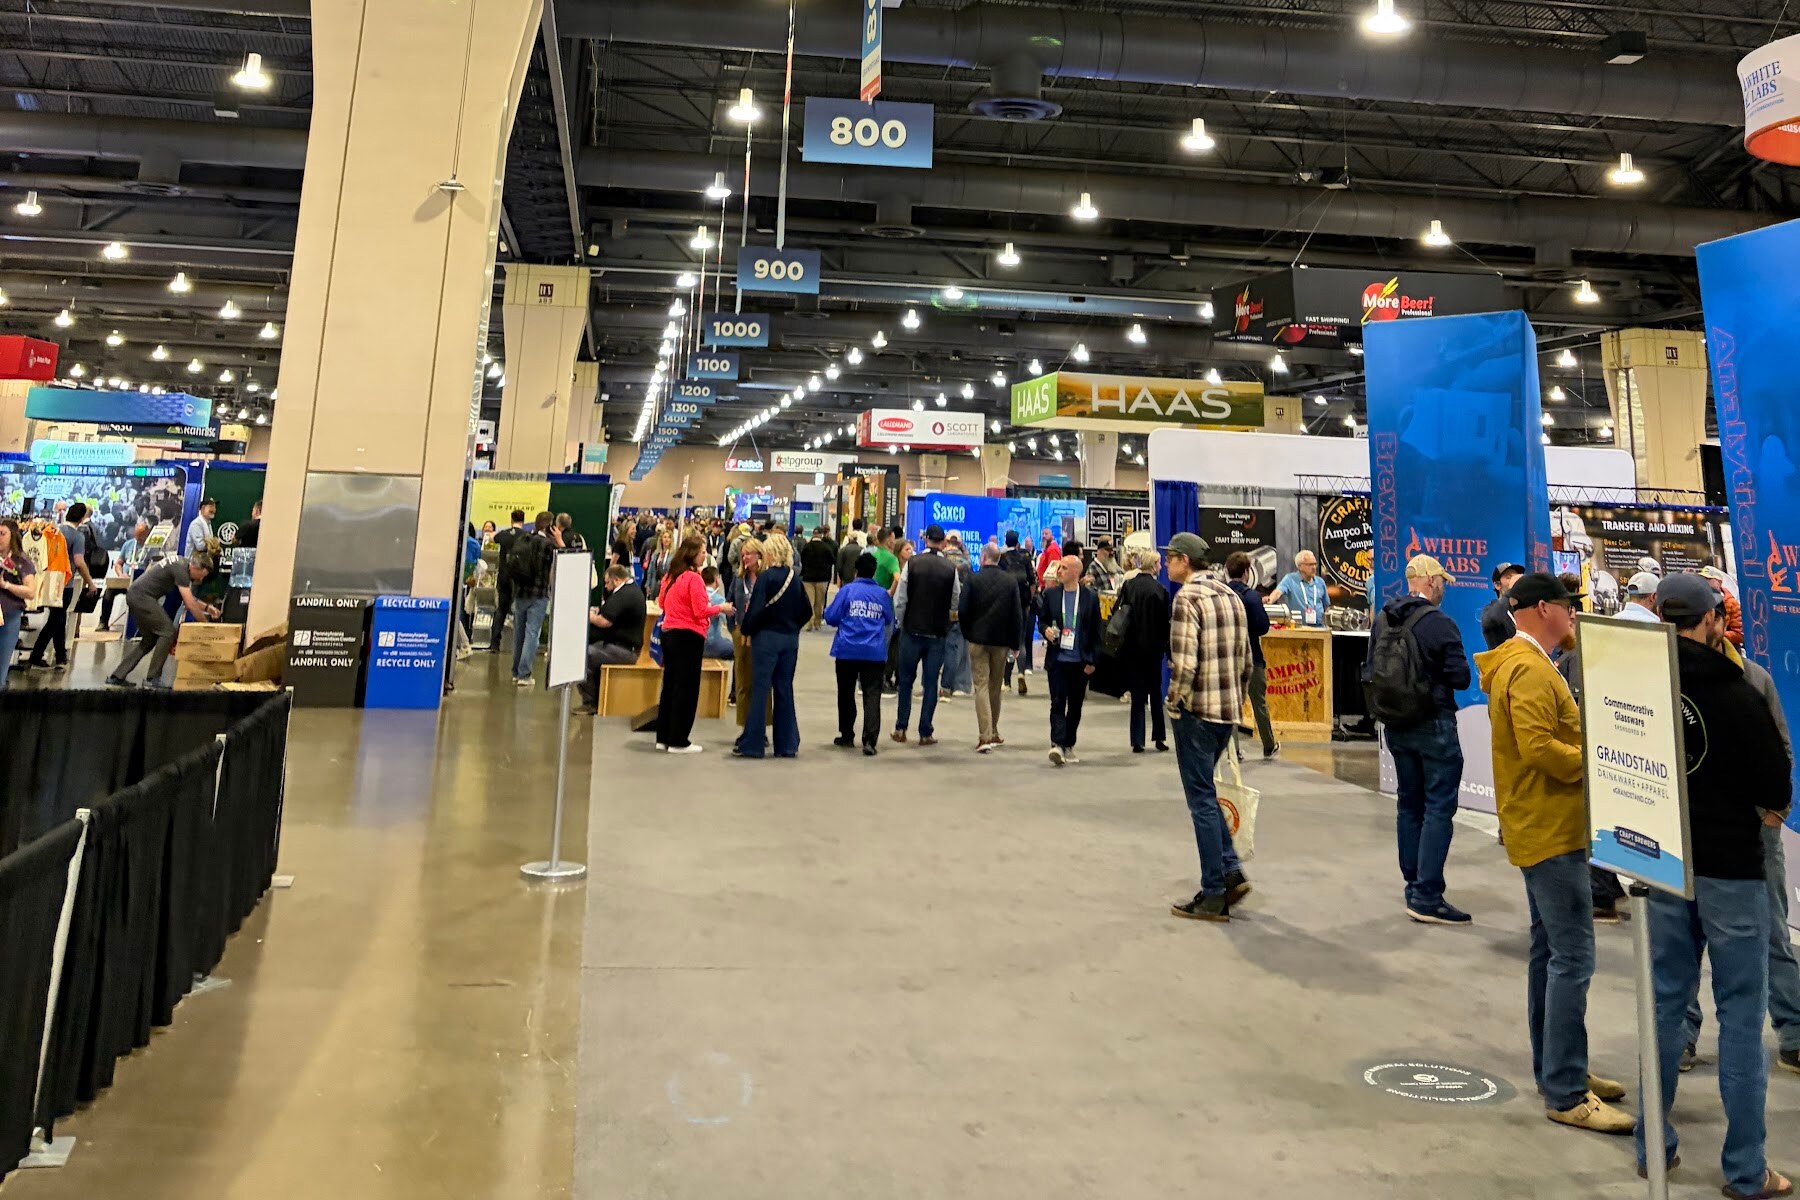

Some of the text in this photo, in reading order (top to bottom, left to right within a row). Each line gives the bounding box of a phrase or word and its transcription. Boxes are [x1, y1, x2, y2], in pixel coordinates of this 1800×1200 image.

[1745, 61, 1782, 89] WHITE
[1750, 80, 1778, 101] LABS
[829, 116, 907, 149] 800
[754, 258, 804, 281] 900
[1401, 308, 1432, 317] Professional
[712, 321, 761, 338] 1000
[696, 358, 730, 372] 1100
[680, 384, 710, 397] 1200
[671, 402, 697, 413] 1300
[1016, 382, 1049, 419] HAAS
[1091, 382, 1232, 420] HAAS
[663, 415, 687, 423] 1400
[947, 422, 979, 432] SCOTT
[658, 428, 678, 436] 1500
[1375, 432, 1398, 572] Brewers
[933, 500, 966, 521] Saxco
[1092, 516, 1106, 525] MB
[1602, 520, 1694, 535] TRANSFER AND MIXING
[1325, 526, 1360, 540] Ampco
[1424, 536, 1488, 556] WHITE
[297, 598, 359, 608] LANDFILL ONLY
[382, 599, 442, 608] RECYCLE ONLY
[850, 609, 880, 619] SECURITY
[290, 658, 354, 667] LANDFILL ONLY
[376, 658, 436, 668] RECYCLE ONLY
[1267, 660, 1315, 680] AMPCO
[1267, 678, 1320, 694] ORIGINAL
[1604, 696, 1654, 717] Commemorative
[1614, 711, 1645, 727] Glassware
[1598, 769, 1636, 789] DRINKWARE
[1641, 783, 1669, 799] APPAREL
[1618, 829, 1656, 850] CRAFT BREWERS
